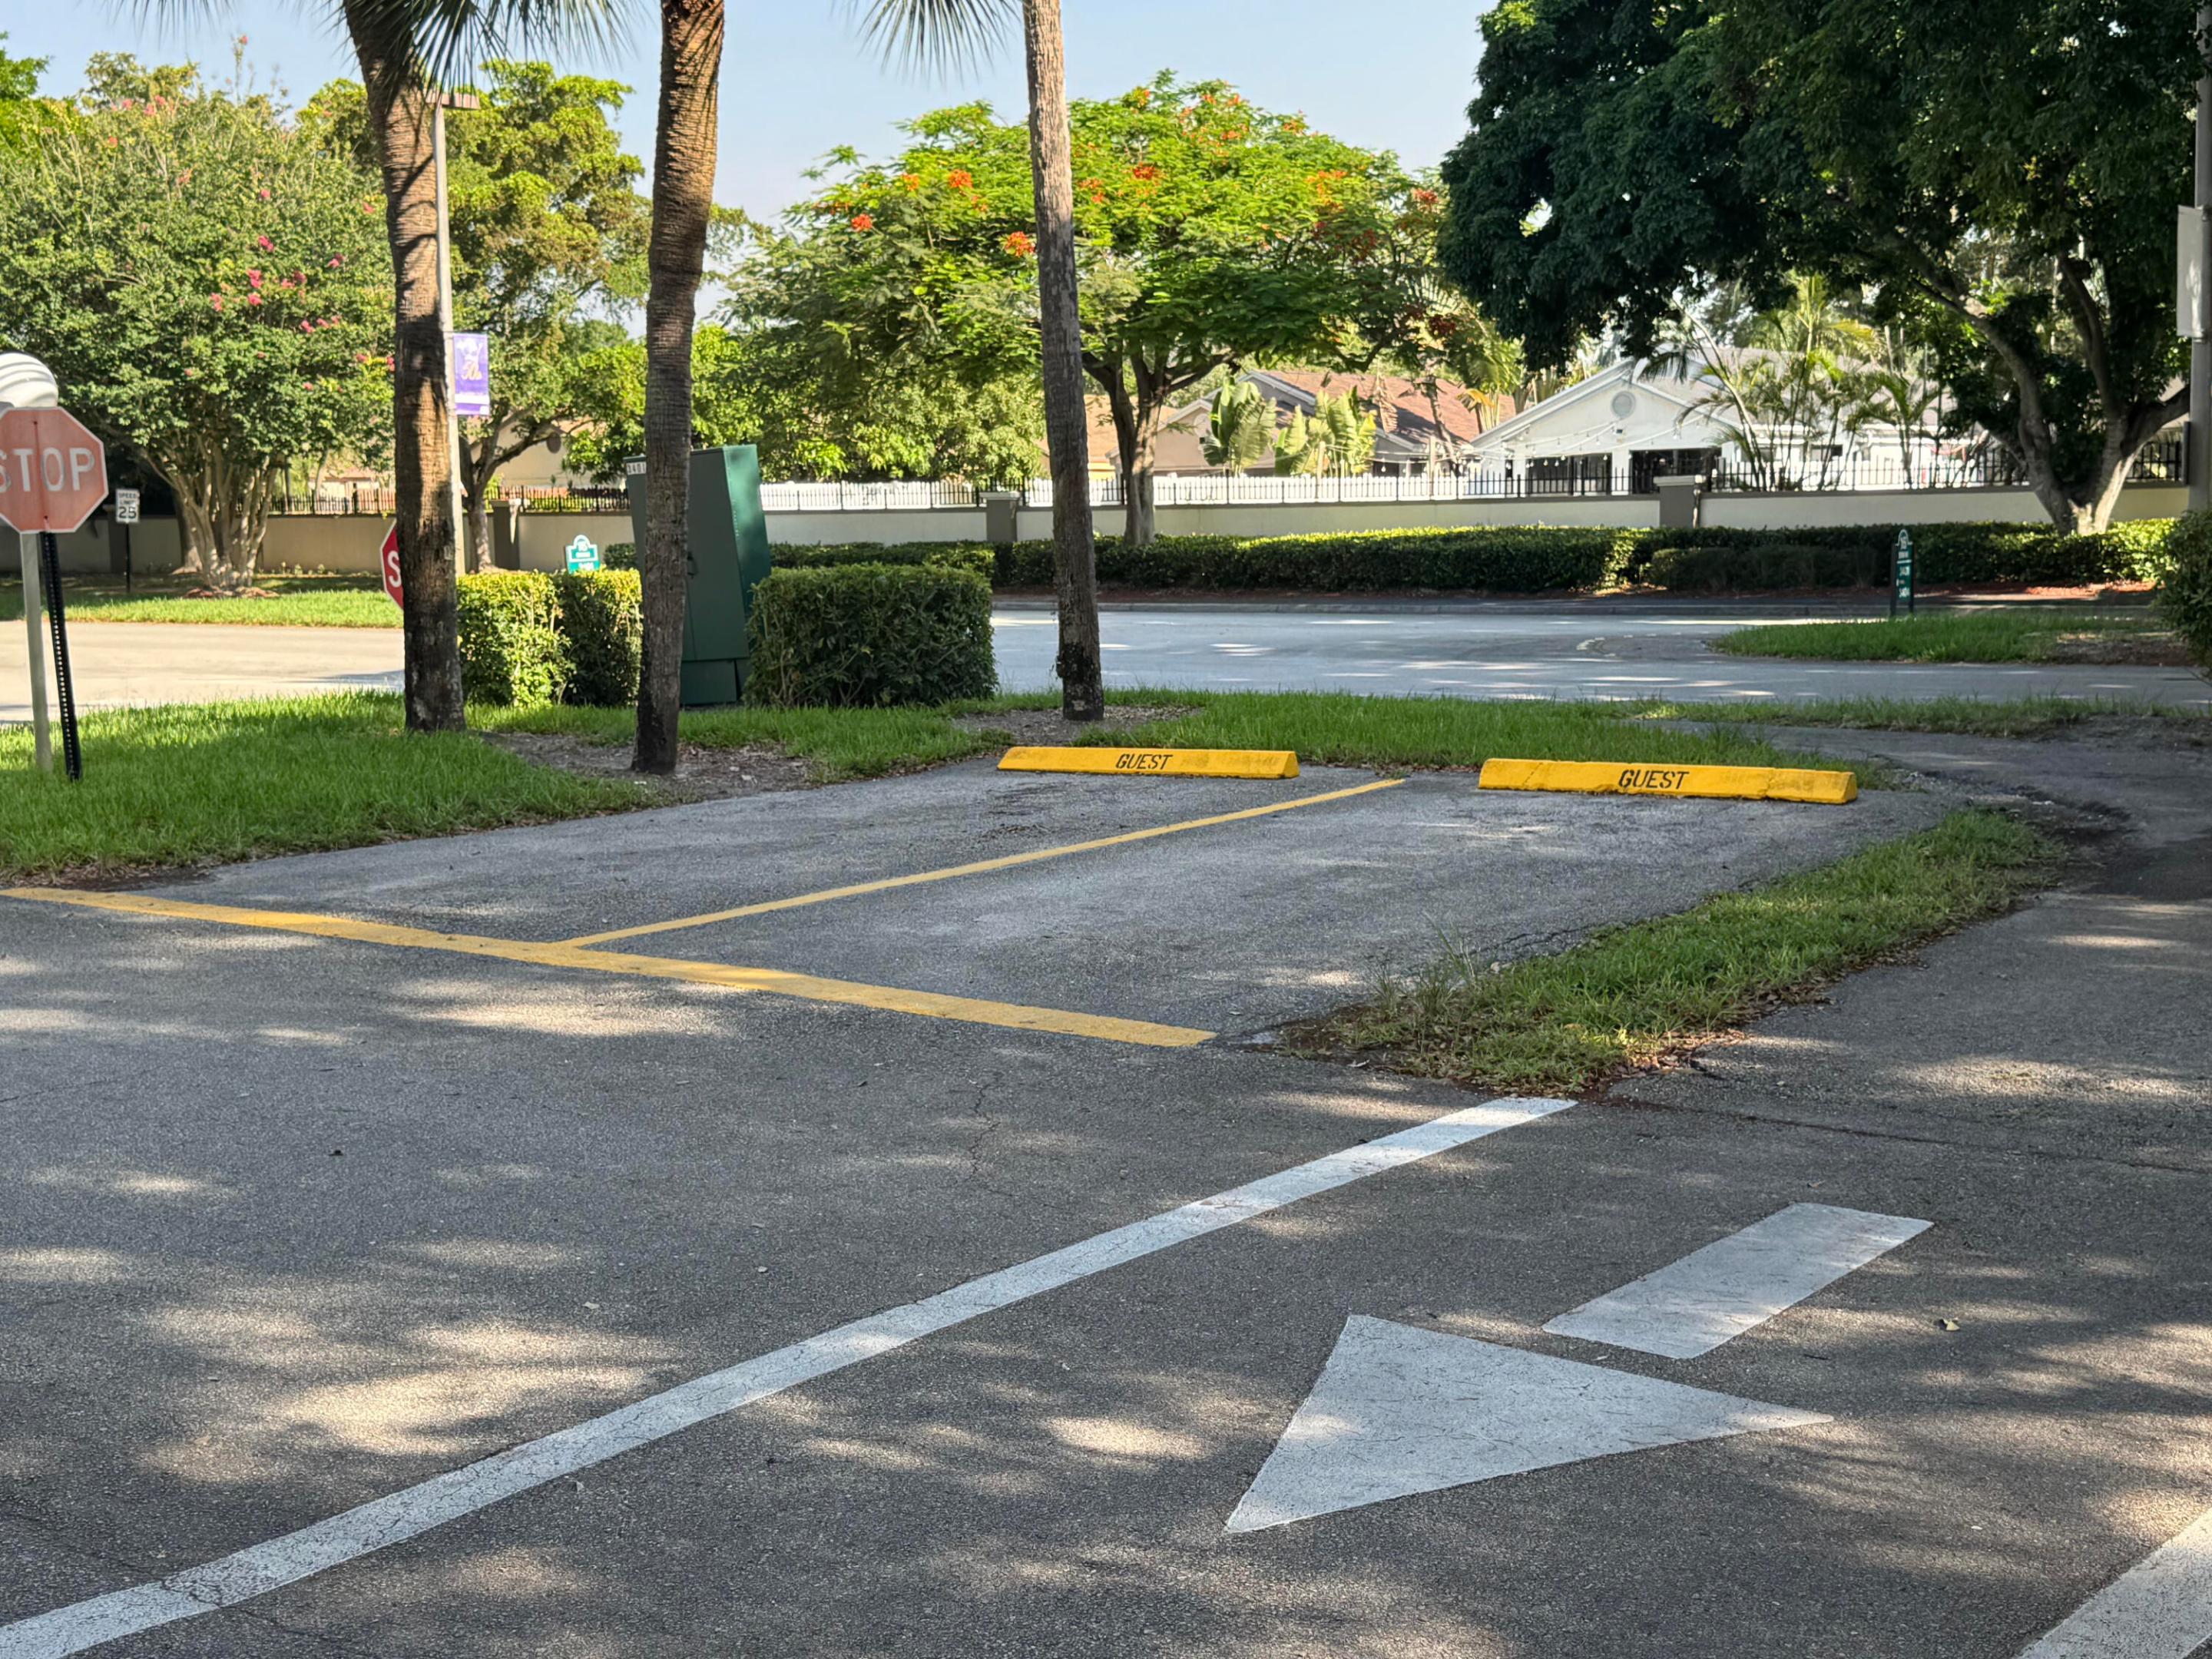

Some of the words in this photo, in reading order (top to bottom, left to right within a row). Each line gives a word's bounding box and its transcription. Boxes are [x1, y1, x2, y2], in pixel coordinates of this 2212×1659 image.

[119, 506, 137, 518] 25
[1115, 753, 1174, 770] GUEST
[1618, 770, 1690, 790] GUEST
